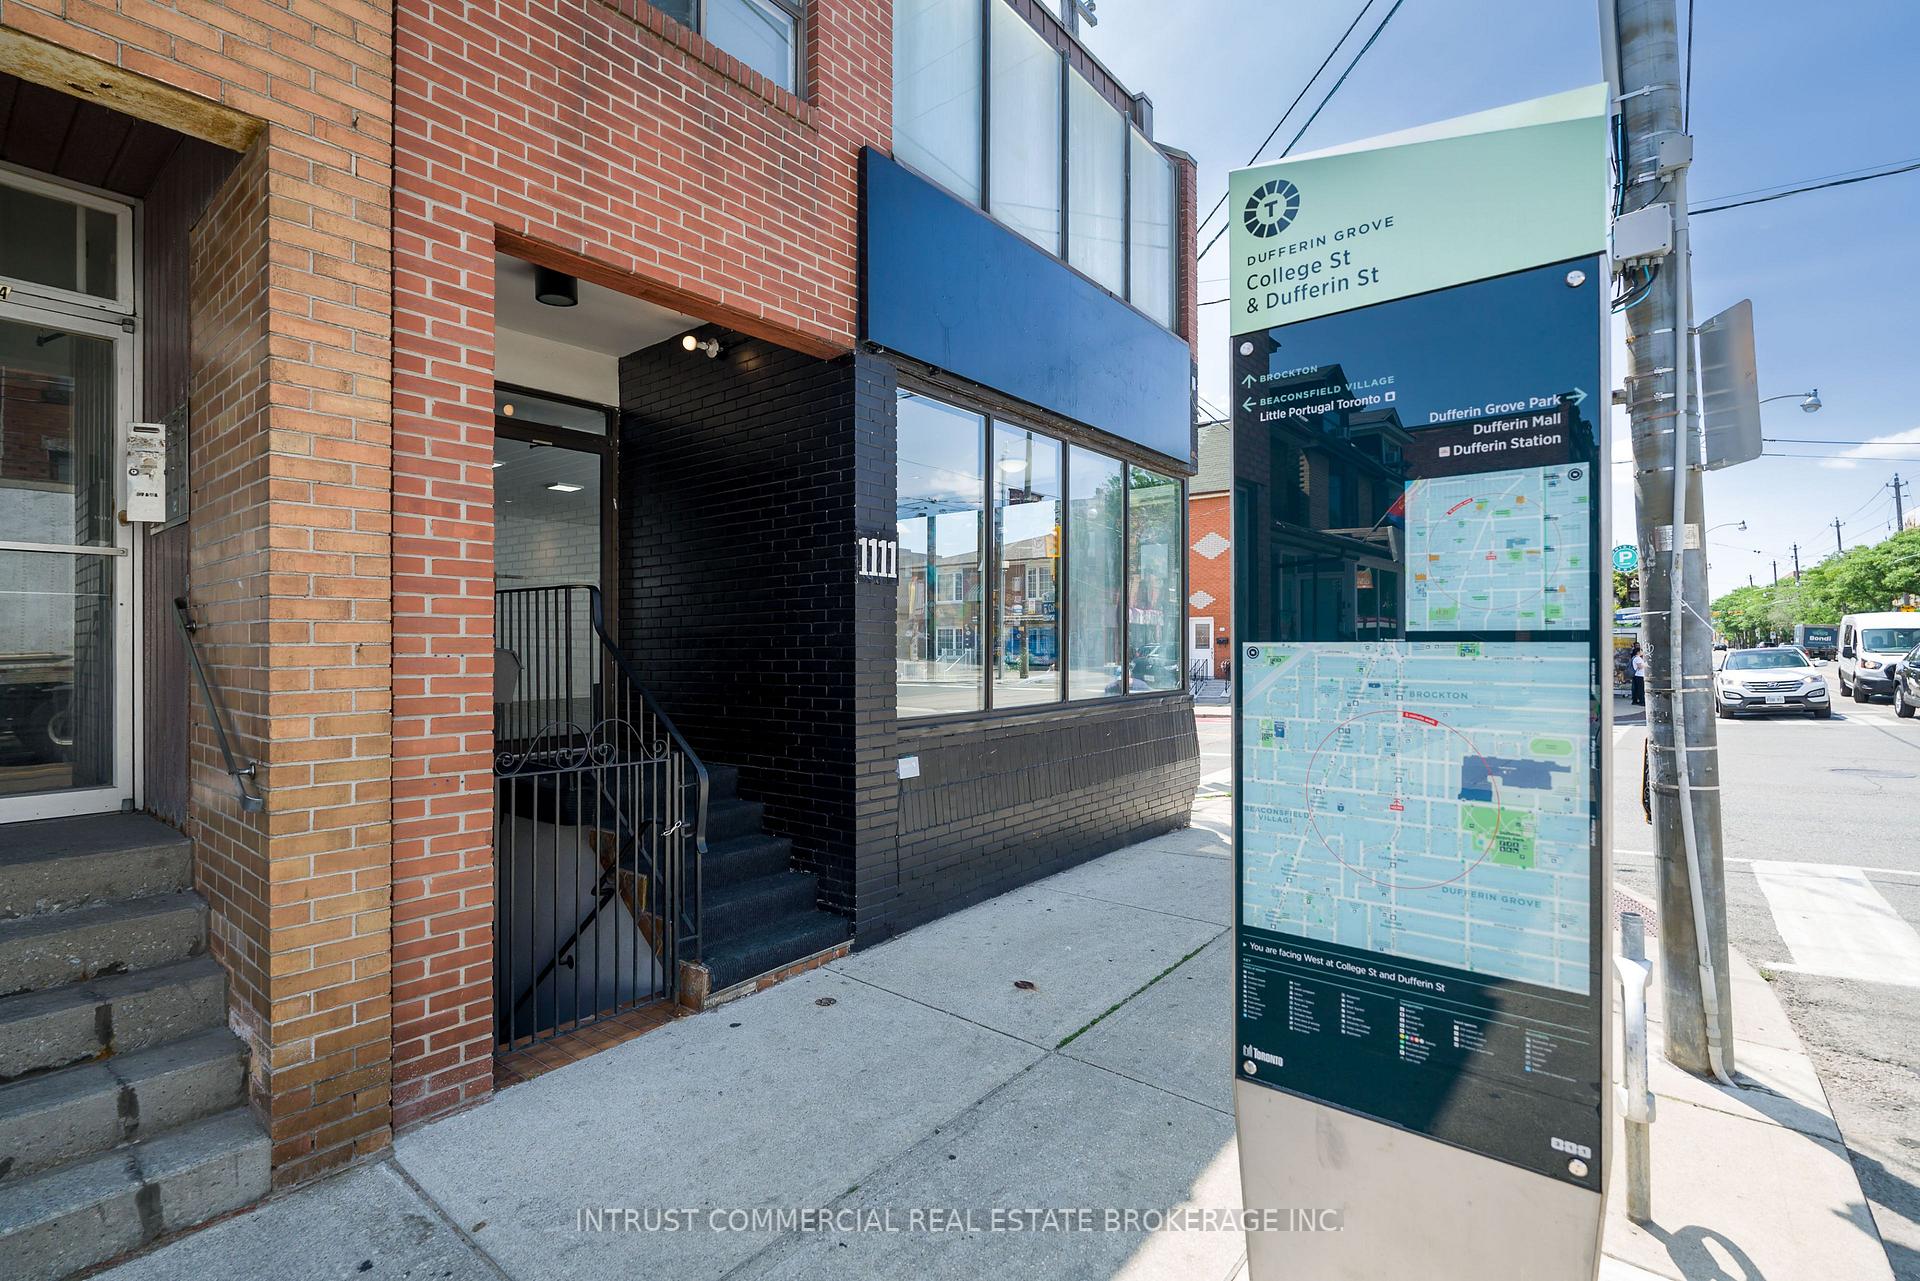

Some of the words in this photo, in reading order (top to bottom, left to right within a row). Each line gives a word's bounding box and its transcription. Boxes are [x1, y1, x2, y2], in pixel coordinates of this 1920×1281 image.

[1264, 200, 1278, 218] T
[1247, 235, 1326, 267] DUFFERIN
[1334, 216, 1394, 241] GROVE
[1247, 260, 1322, 290] College
[1330, 250, 1351, 269] St
[1247, 297, 1259, 314] &
[1266, 276, 1349, 309] Dufferin
[1357, 267, 1379, 286] St
[1259, 365, 1318, 383] BROCKTON
[1259, 385, 1341, 406] BEACONSFIELD
[1345, 375, 1395, 391] VILLAGE
[1260, 409, 1286, 422] Little
[1288, 399, 1334, 418] Portugal
[1336, 394, 1381, 409] Toronto
[1429, 406, 1481, 423] Dufferin
[1485, 400, 1525, 415] Grove
[1529, 394, 1561, 408] Park
[1473, 418, 1528, 435] Dufferin
[1532, 412, 1561, 427] Mall
[1453, 440, 1507, 456] Dufferin
[1510, 434, 1561, 449] Station
[859, 537, 897, 578] 1111
[1619, 551, 1632, 563] P
[1409, 690, 1468, 700] BROCKTON
[1245, 805, 1310, 819] BEACONSFIELD
[1501, 896, 1542, 909] GROVE
[1250, 942, 1264, 951] You
[1265, 946, 1278, 955] are
[1279, 947, 1302, 961] facing
[1303, 954, 1324, 966] West
[1326, 959, 1334, 967] at
[1336, 961, 1367, 976] College
[1368, 967, 1377, 977] St
[1379, 970, 1395, 981] and
[1397, 974, 1434, 989] Dufferin
[1435, 982, 1445, 992] St
[1253, 1047, 1284, 1067] TORONTO
